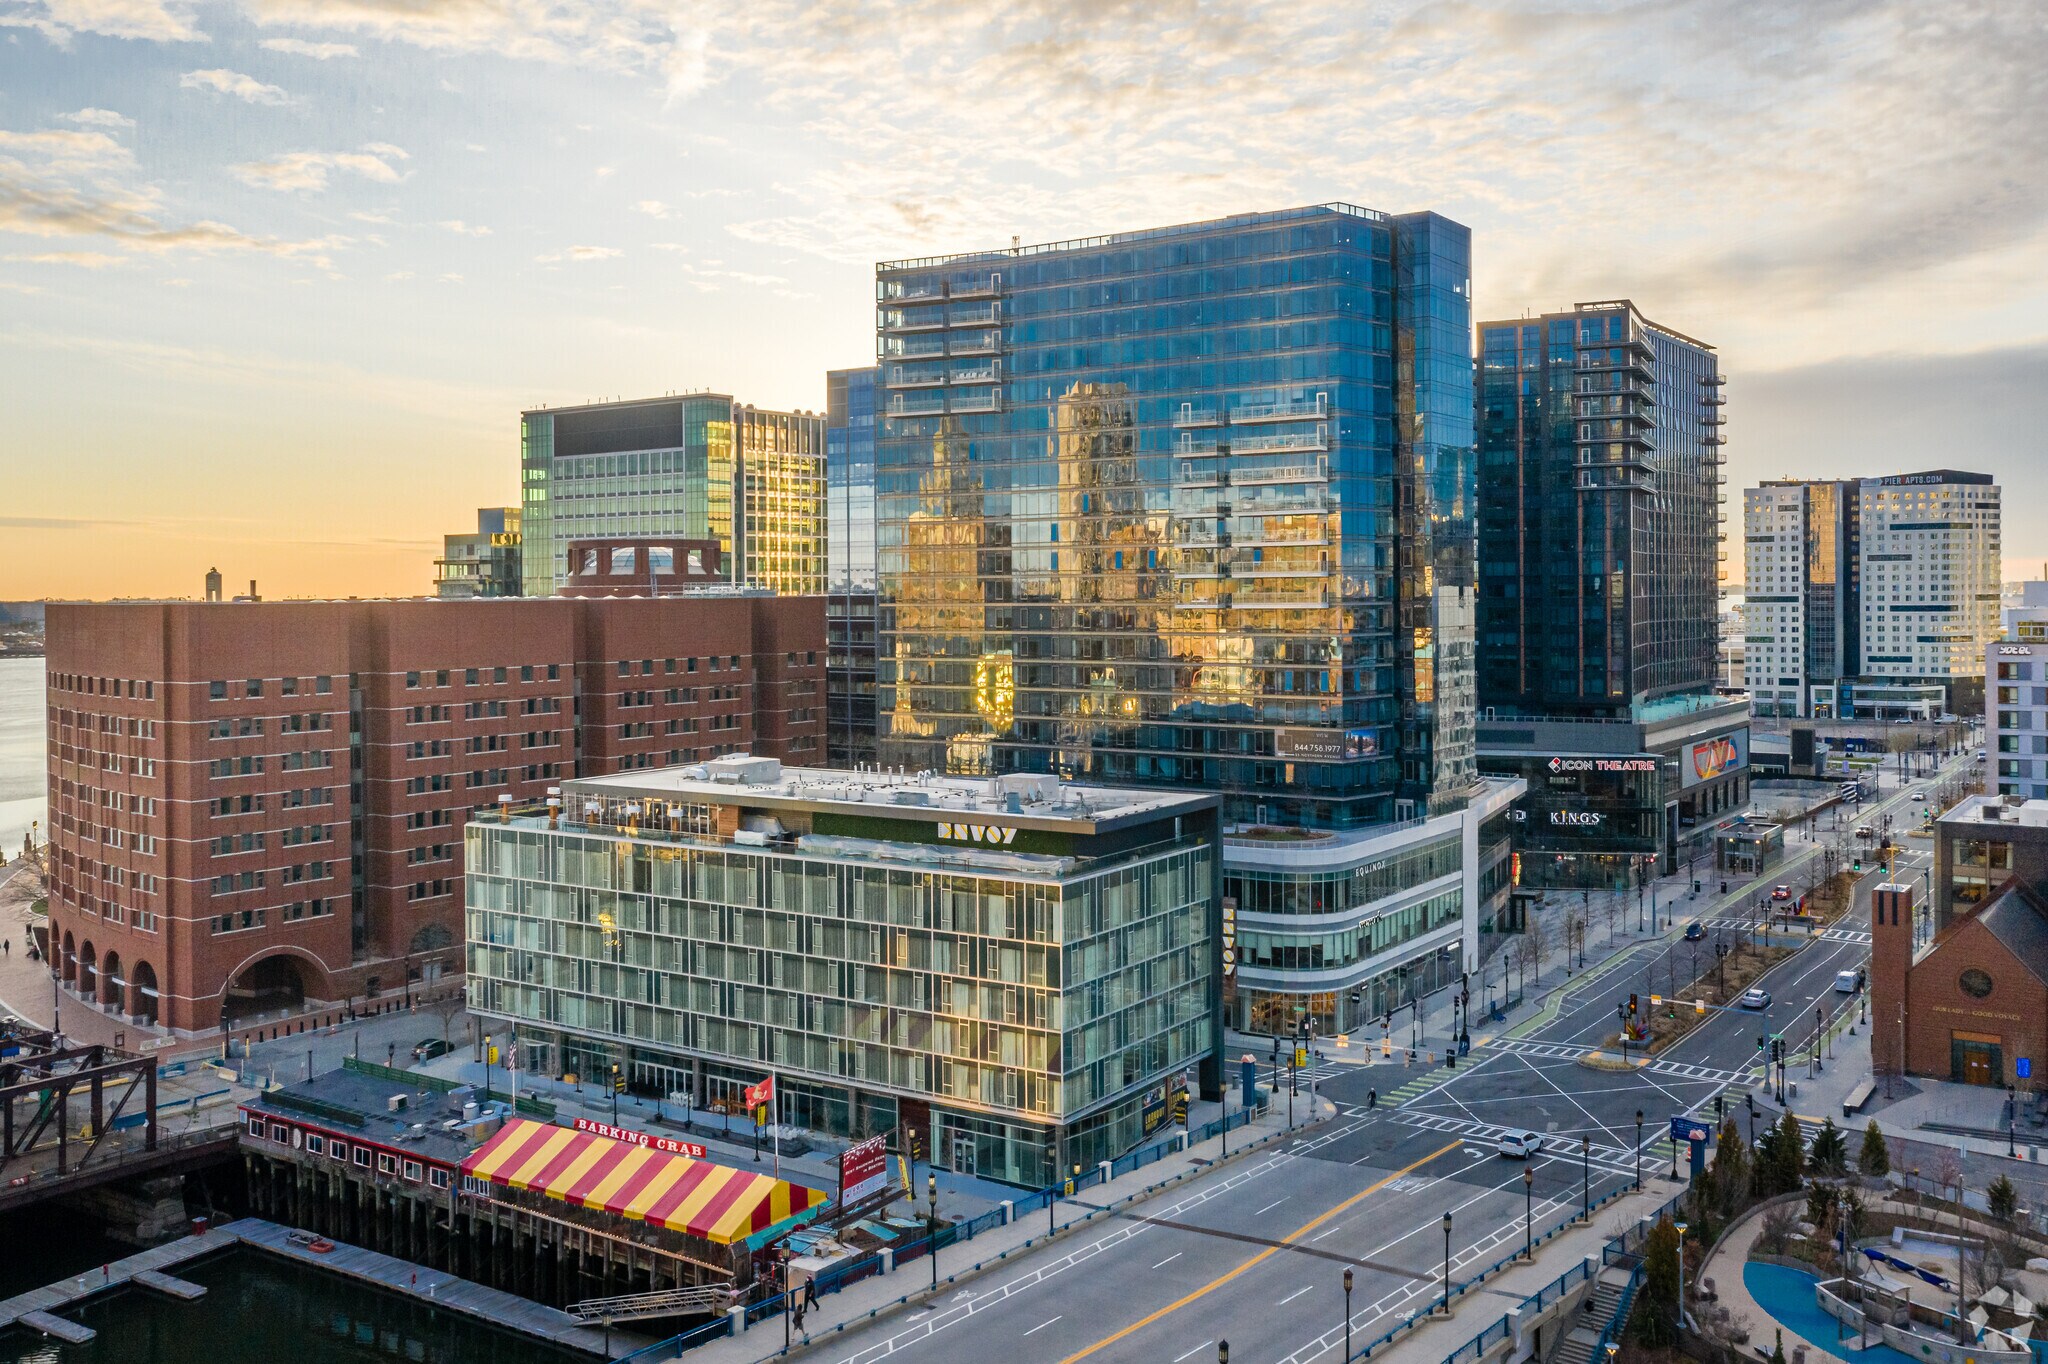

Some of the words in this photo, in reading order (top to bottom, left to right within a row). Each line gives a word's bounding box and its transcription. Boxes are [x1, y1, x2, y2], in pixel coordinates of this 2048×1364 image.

[1294, 743, 1341, 753] 844.758.1977
[1561, 760, 1593, 771] ICON
[1595, 760, 1656, 771] THEATRE
[938, 822, 1018, 844] ENVOY
[1355, 860, 1386, 877] EQUINOX
[1222, 908, 1235, 976] ENVOY
[1972, 1010, 1993, 1018] GOOD
[578, 1119, 649, 1146] BARKING
[656, 1139, 702, 1156] CRAB
